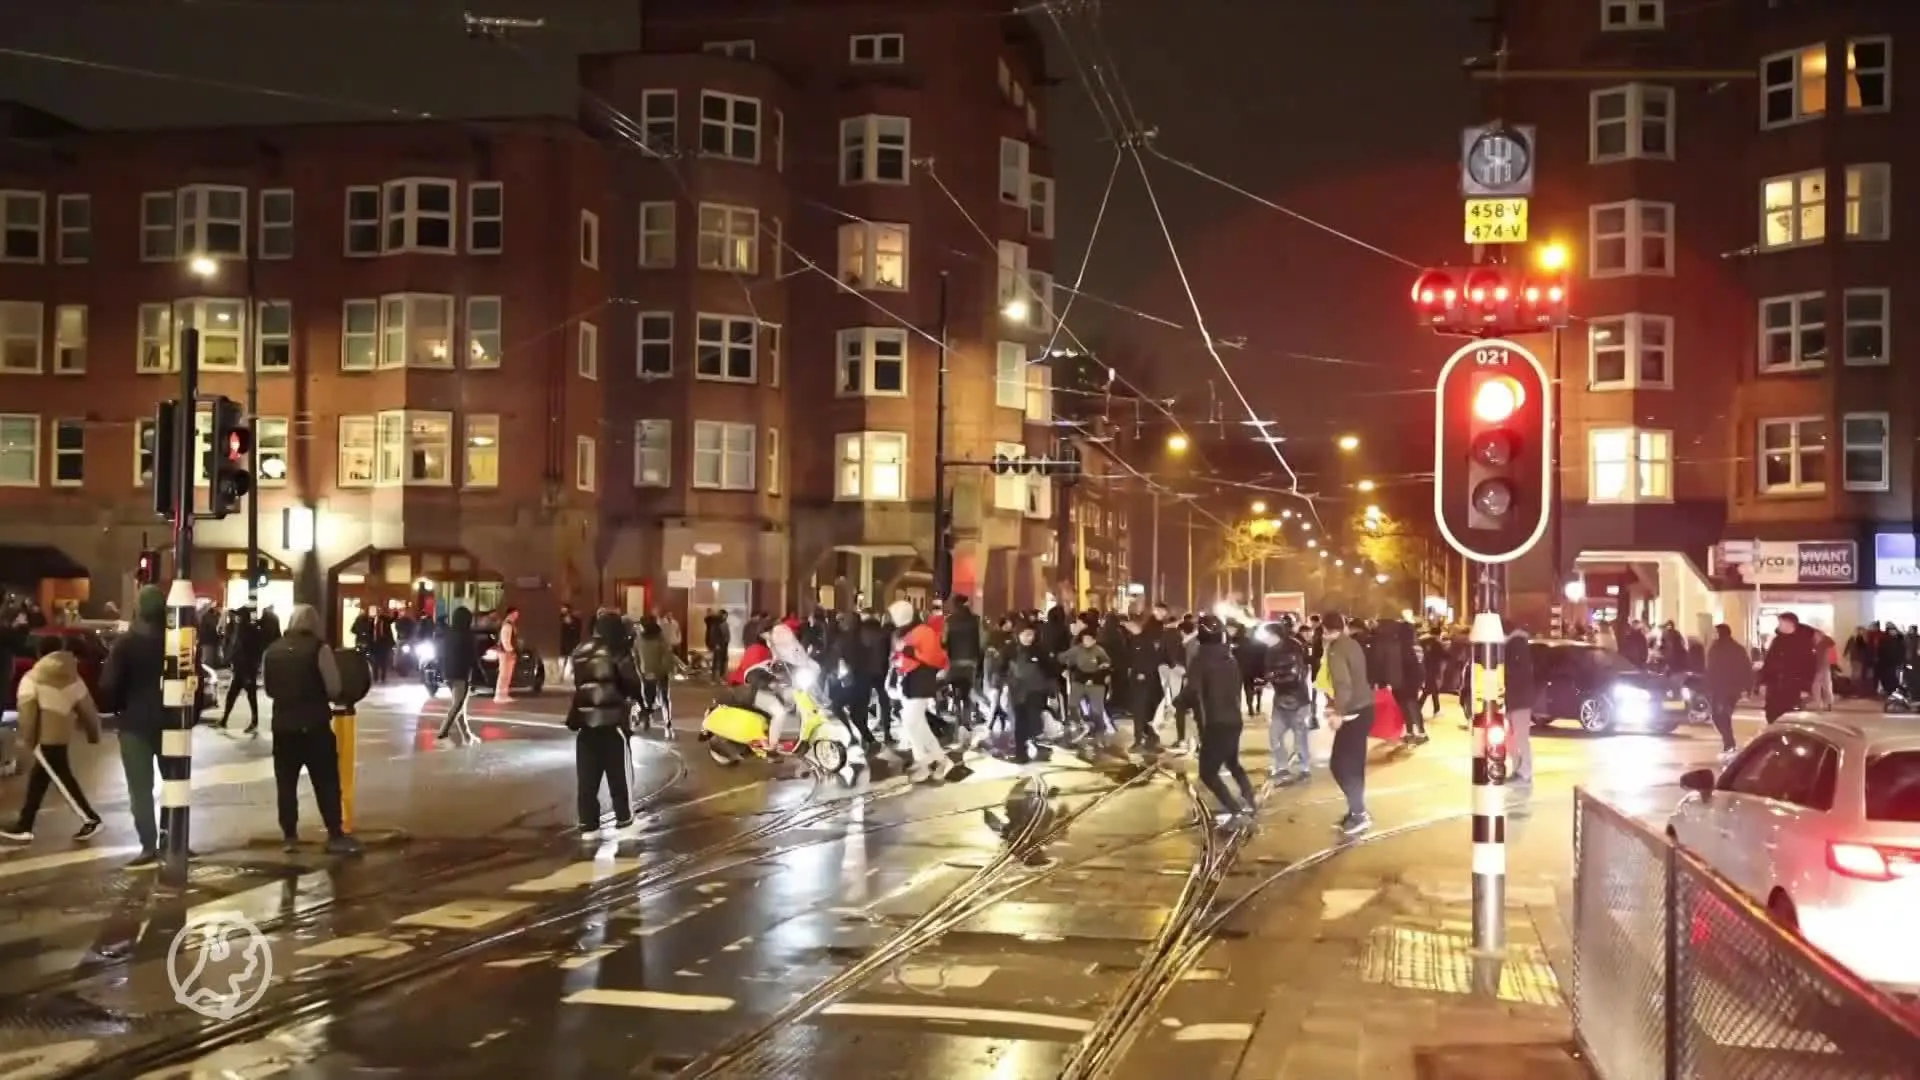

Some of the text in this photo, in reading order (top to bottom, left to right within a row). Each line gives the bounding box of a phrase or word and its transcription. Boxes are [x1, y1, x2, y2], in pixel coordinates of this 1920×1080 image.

[1471, 203, 1521, 218] 458-V
[1471, 224, 1520, 239] 474-V
[1476, 350, 1509, 364] 021
[1758, 556, 1785, 569] yca
[1800, 550, 1849, 562] VIVANT
[1800, 564, 1852, 577] MUNDO
